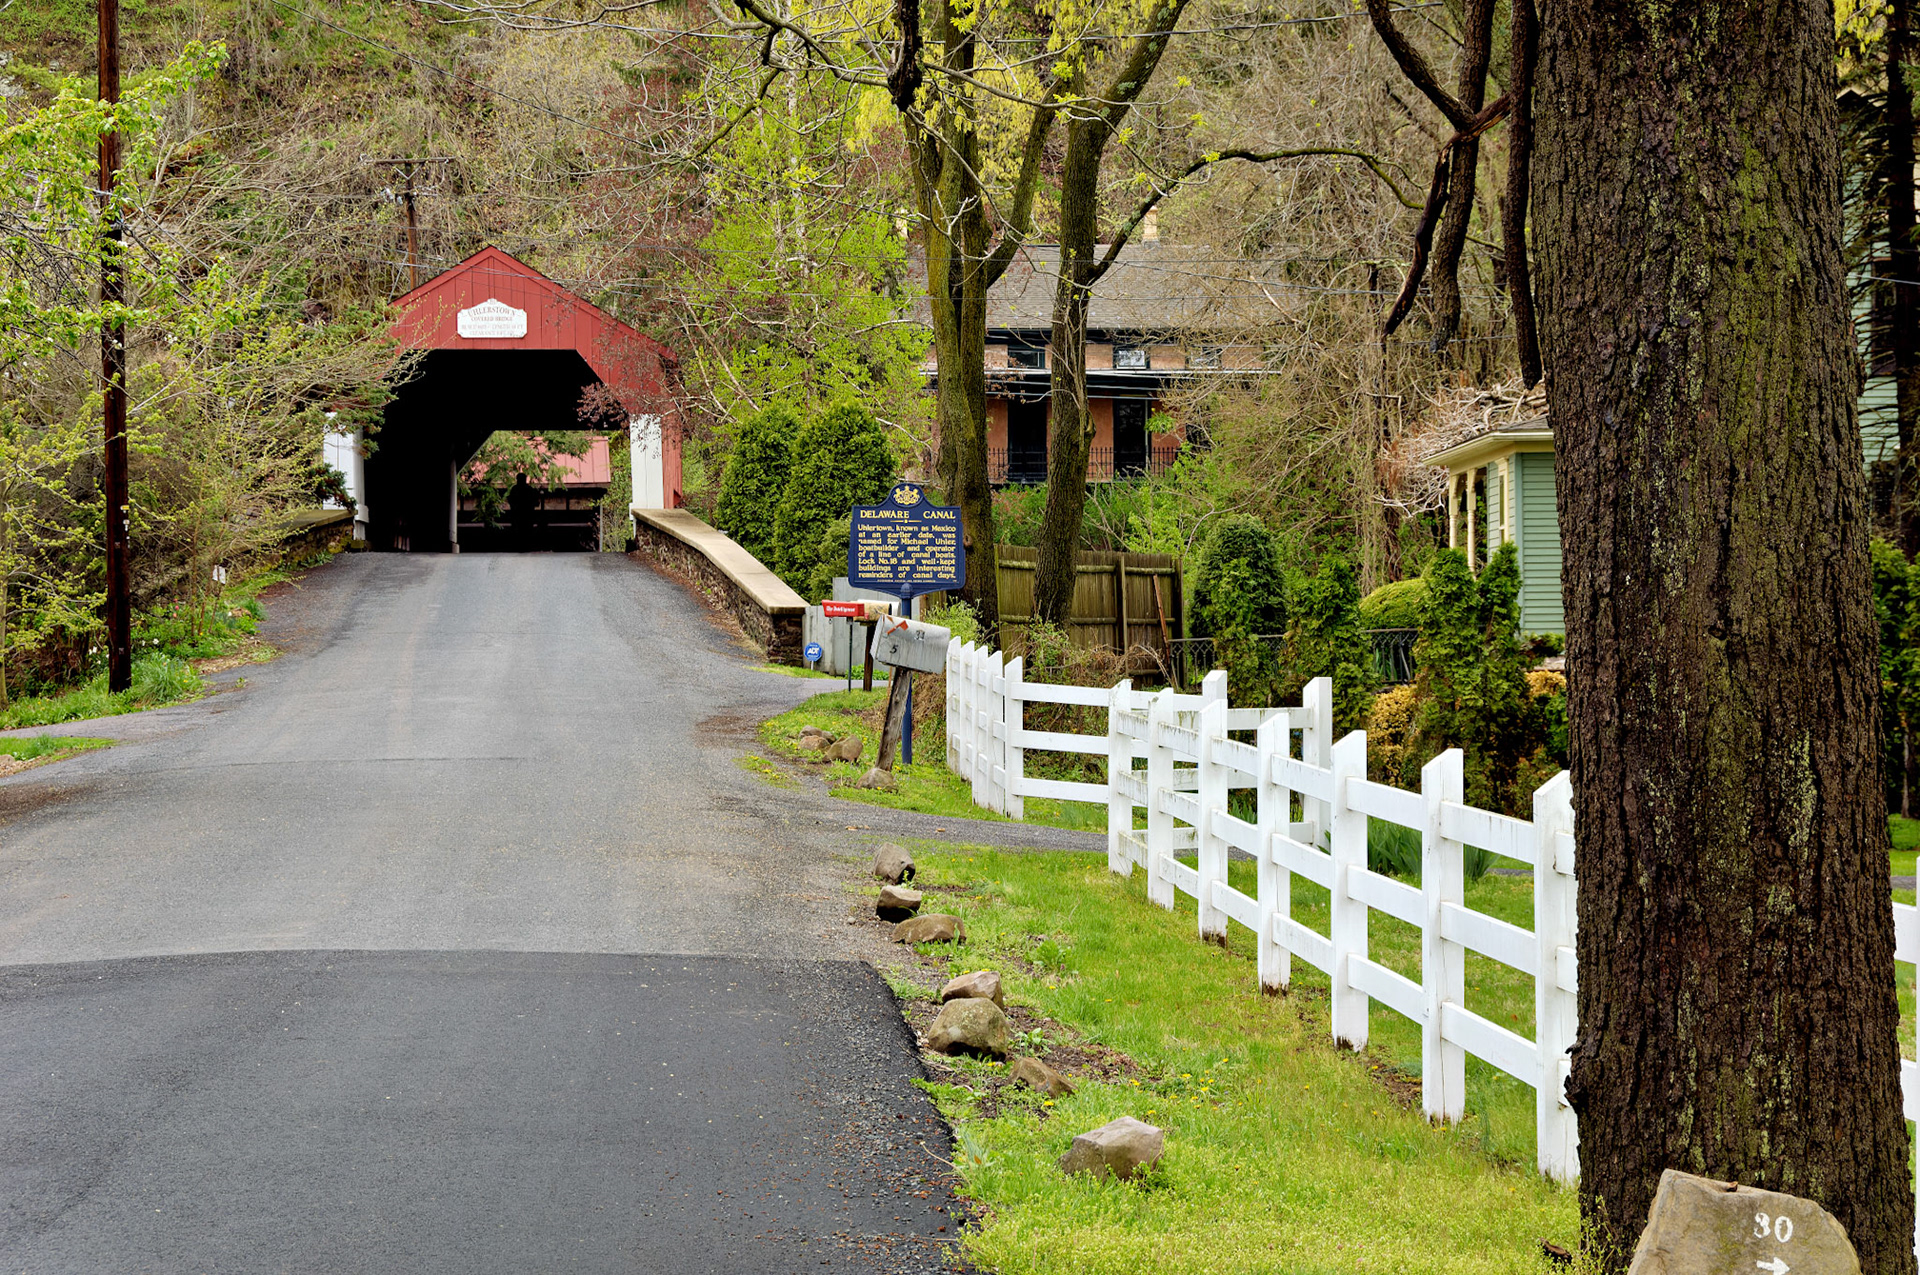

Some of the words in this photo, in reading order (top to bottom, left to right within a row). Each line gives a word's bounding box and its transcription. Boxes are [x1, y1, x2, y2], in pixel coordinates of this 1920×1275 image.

[860, 510, 910, 518] DELAWARE
[922, 510, 956, 519] CANAL
[858, 564, 891, 572] buildings
[916, 565, 955, 573] interesting
[890, 644, 899, 654] 5
[1753, 1212, 1794, 1244] 30
